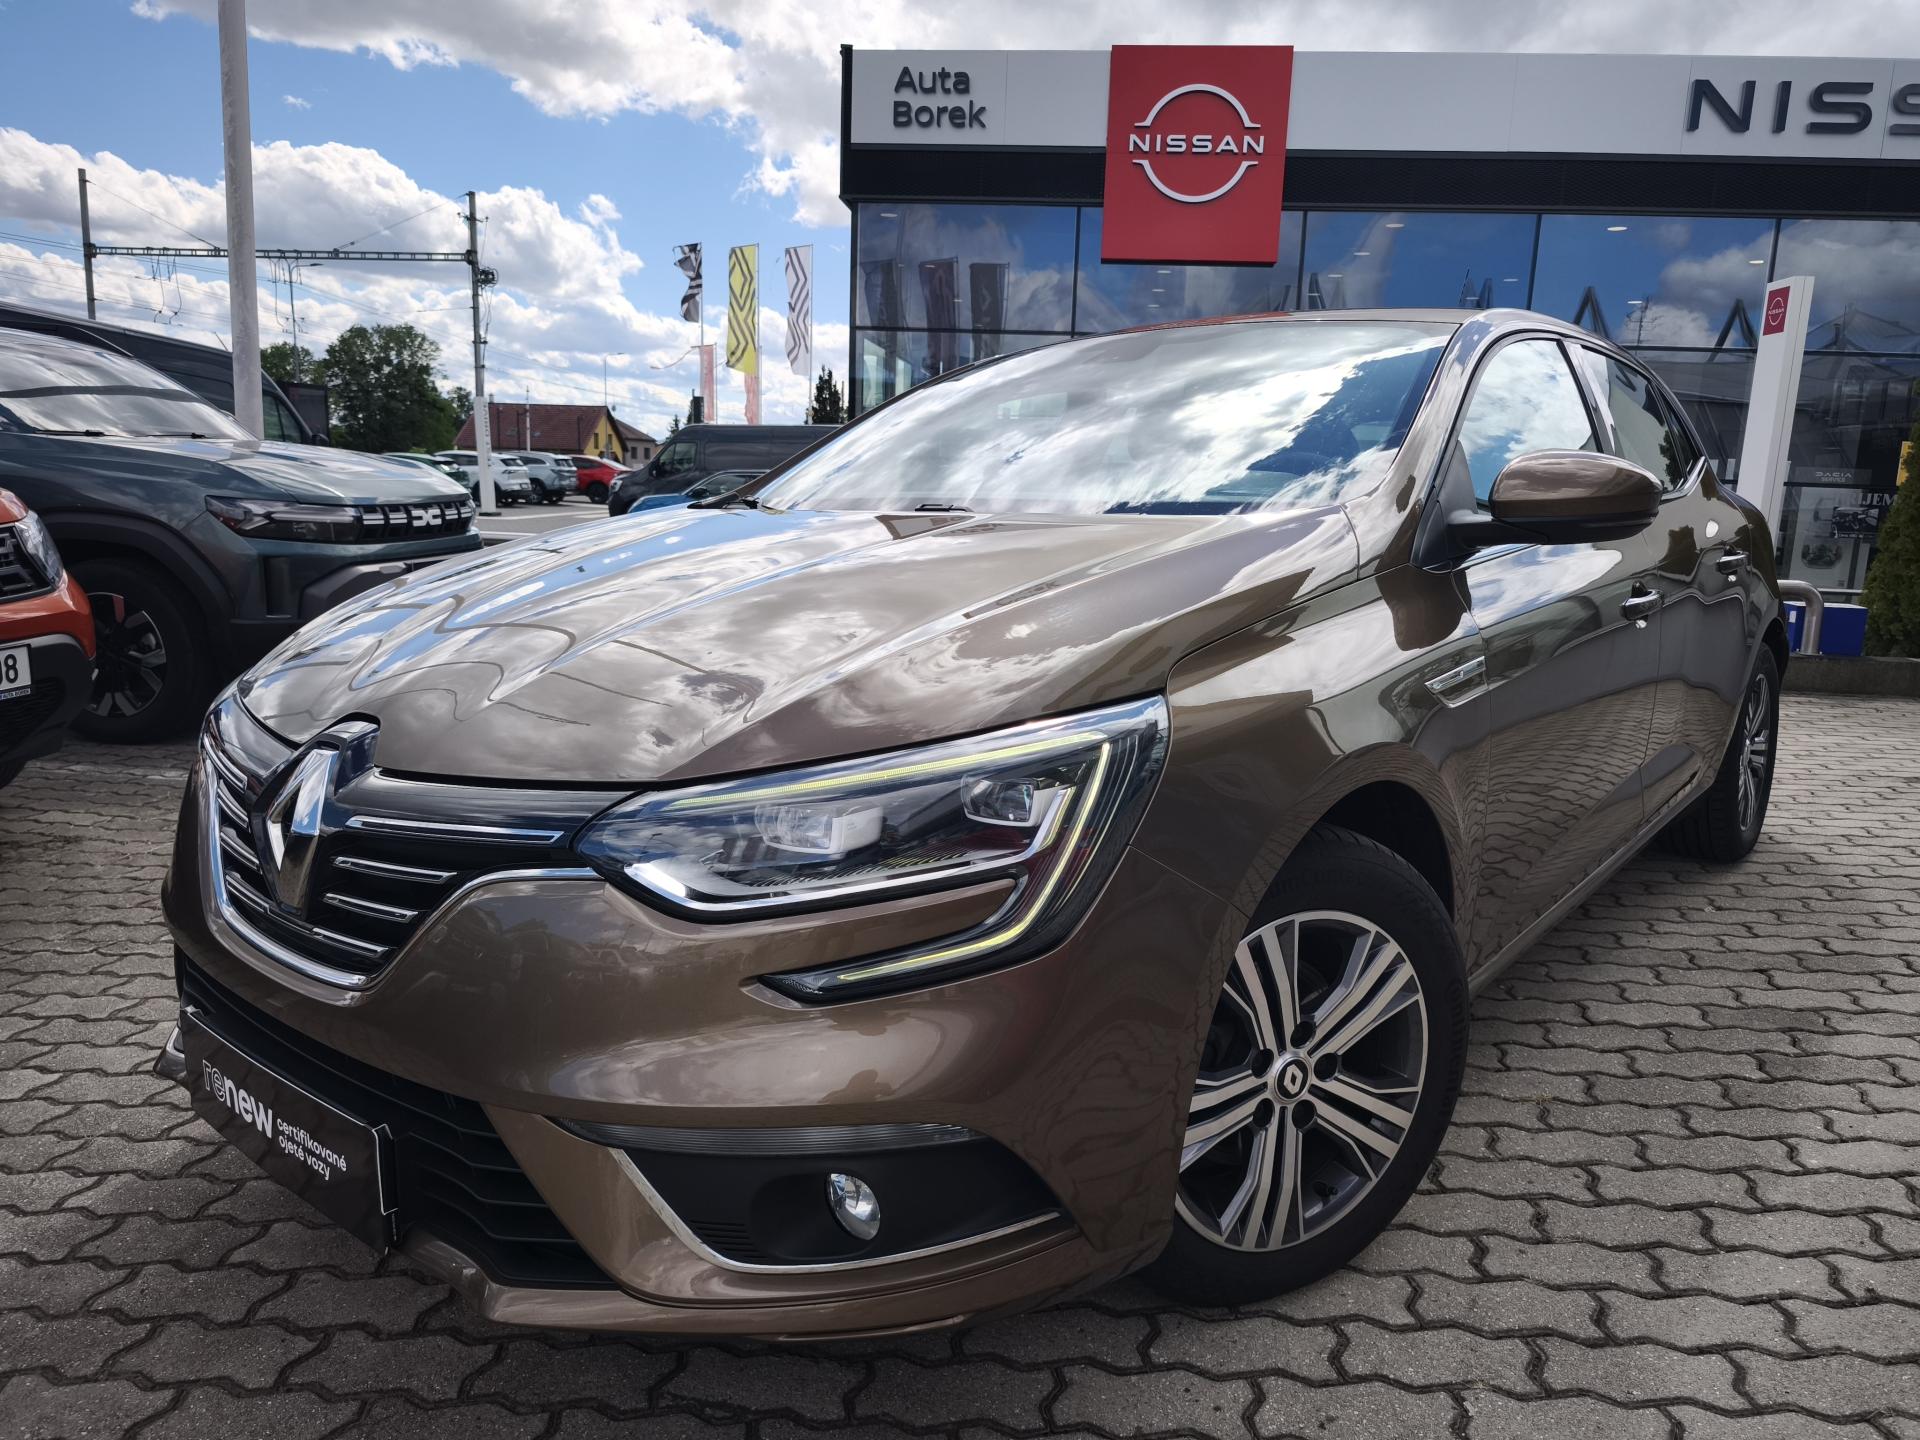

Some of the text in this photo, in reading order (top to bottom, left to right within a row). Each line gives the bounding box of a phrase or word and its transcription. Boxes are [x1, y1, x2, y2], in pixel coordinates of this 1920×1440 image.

[894, 66, 970, 94] Auta
[892, 100, 987, 129] Borek
[1128, 133, 1265, 154] NISSAN
[0, 653, 19, 685] 8
[202, 1059, 273, 1139] renew
[276, 1118, 347, 1172] certifikované
[278, 1135, 331, 1181] ojeté vozy
